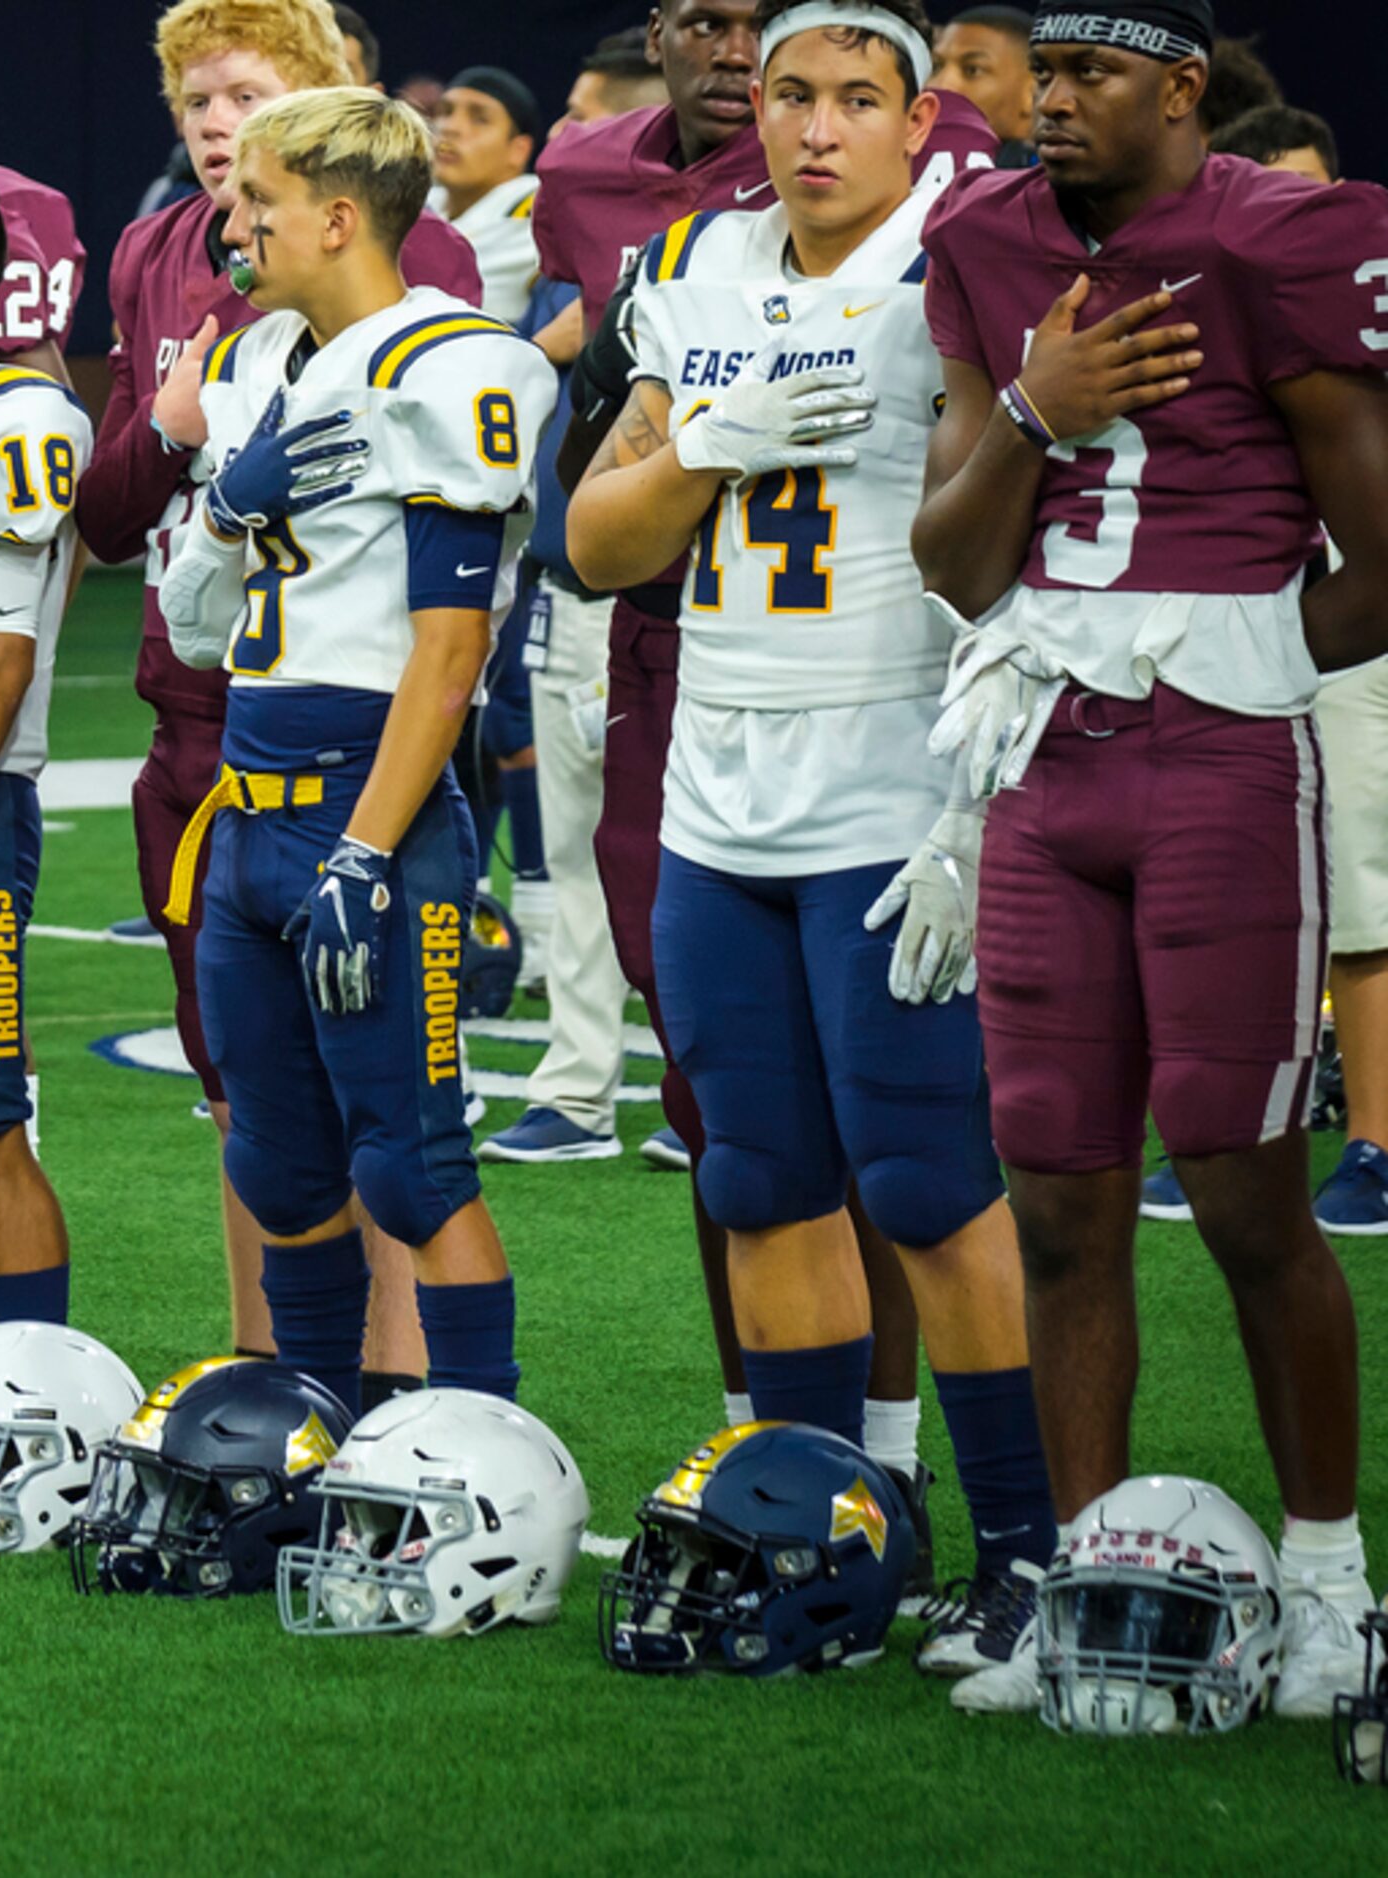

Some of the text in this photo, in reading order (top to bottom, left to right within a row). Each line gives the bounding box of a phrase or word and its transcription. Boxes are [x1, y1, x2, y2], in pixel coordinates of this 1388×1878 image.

[1039, 13, 1169, 54] NIKE PRO
[471, 387, 520, 470] 8
[1041, 414, 1149, 589] 3
[419, 902, 461, 1086] TROOPERS
